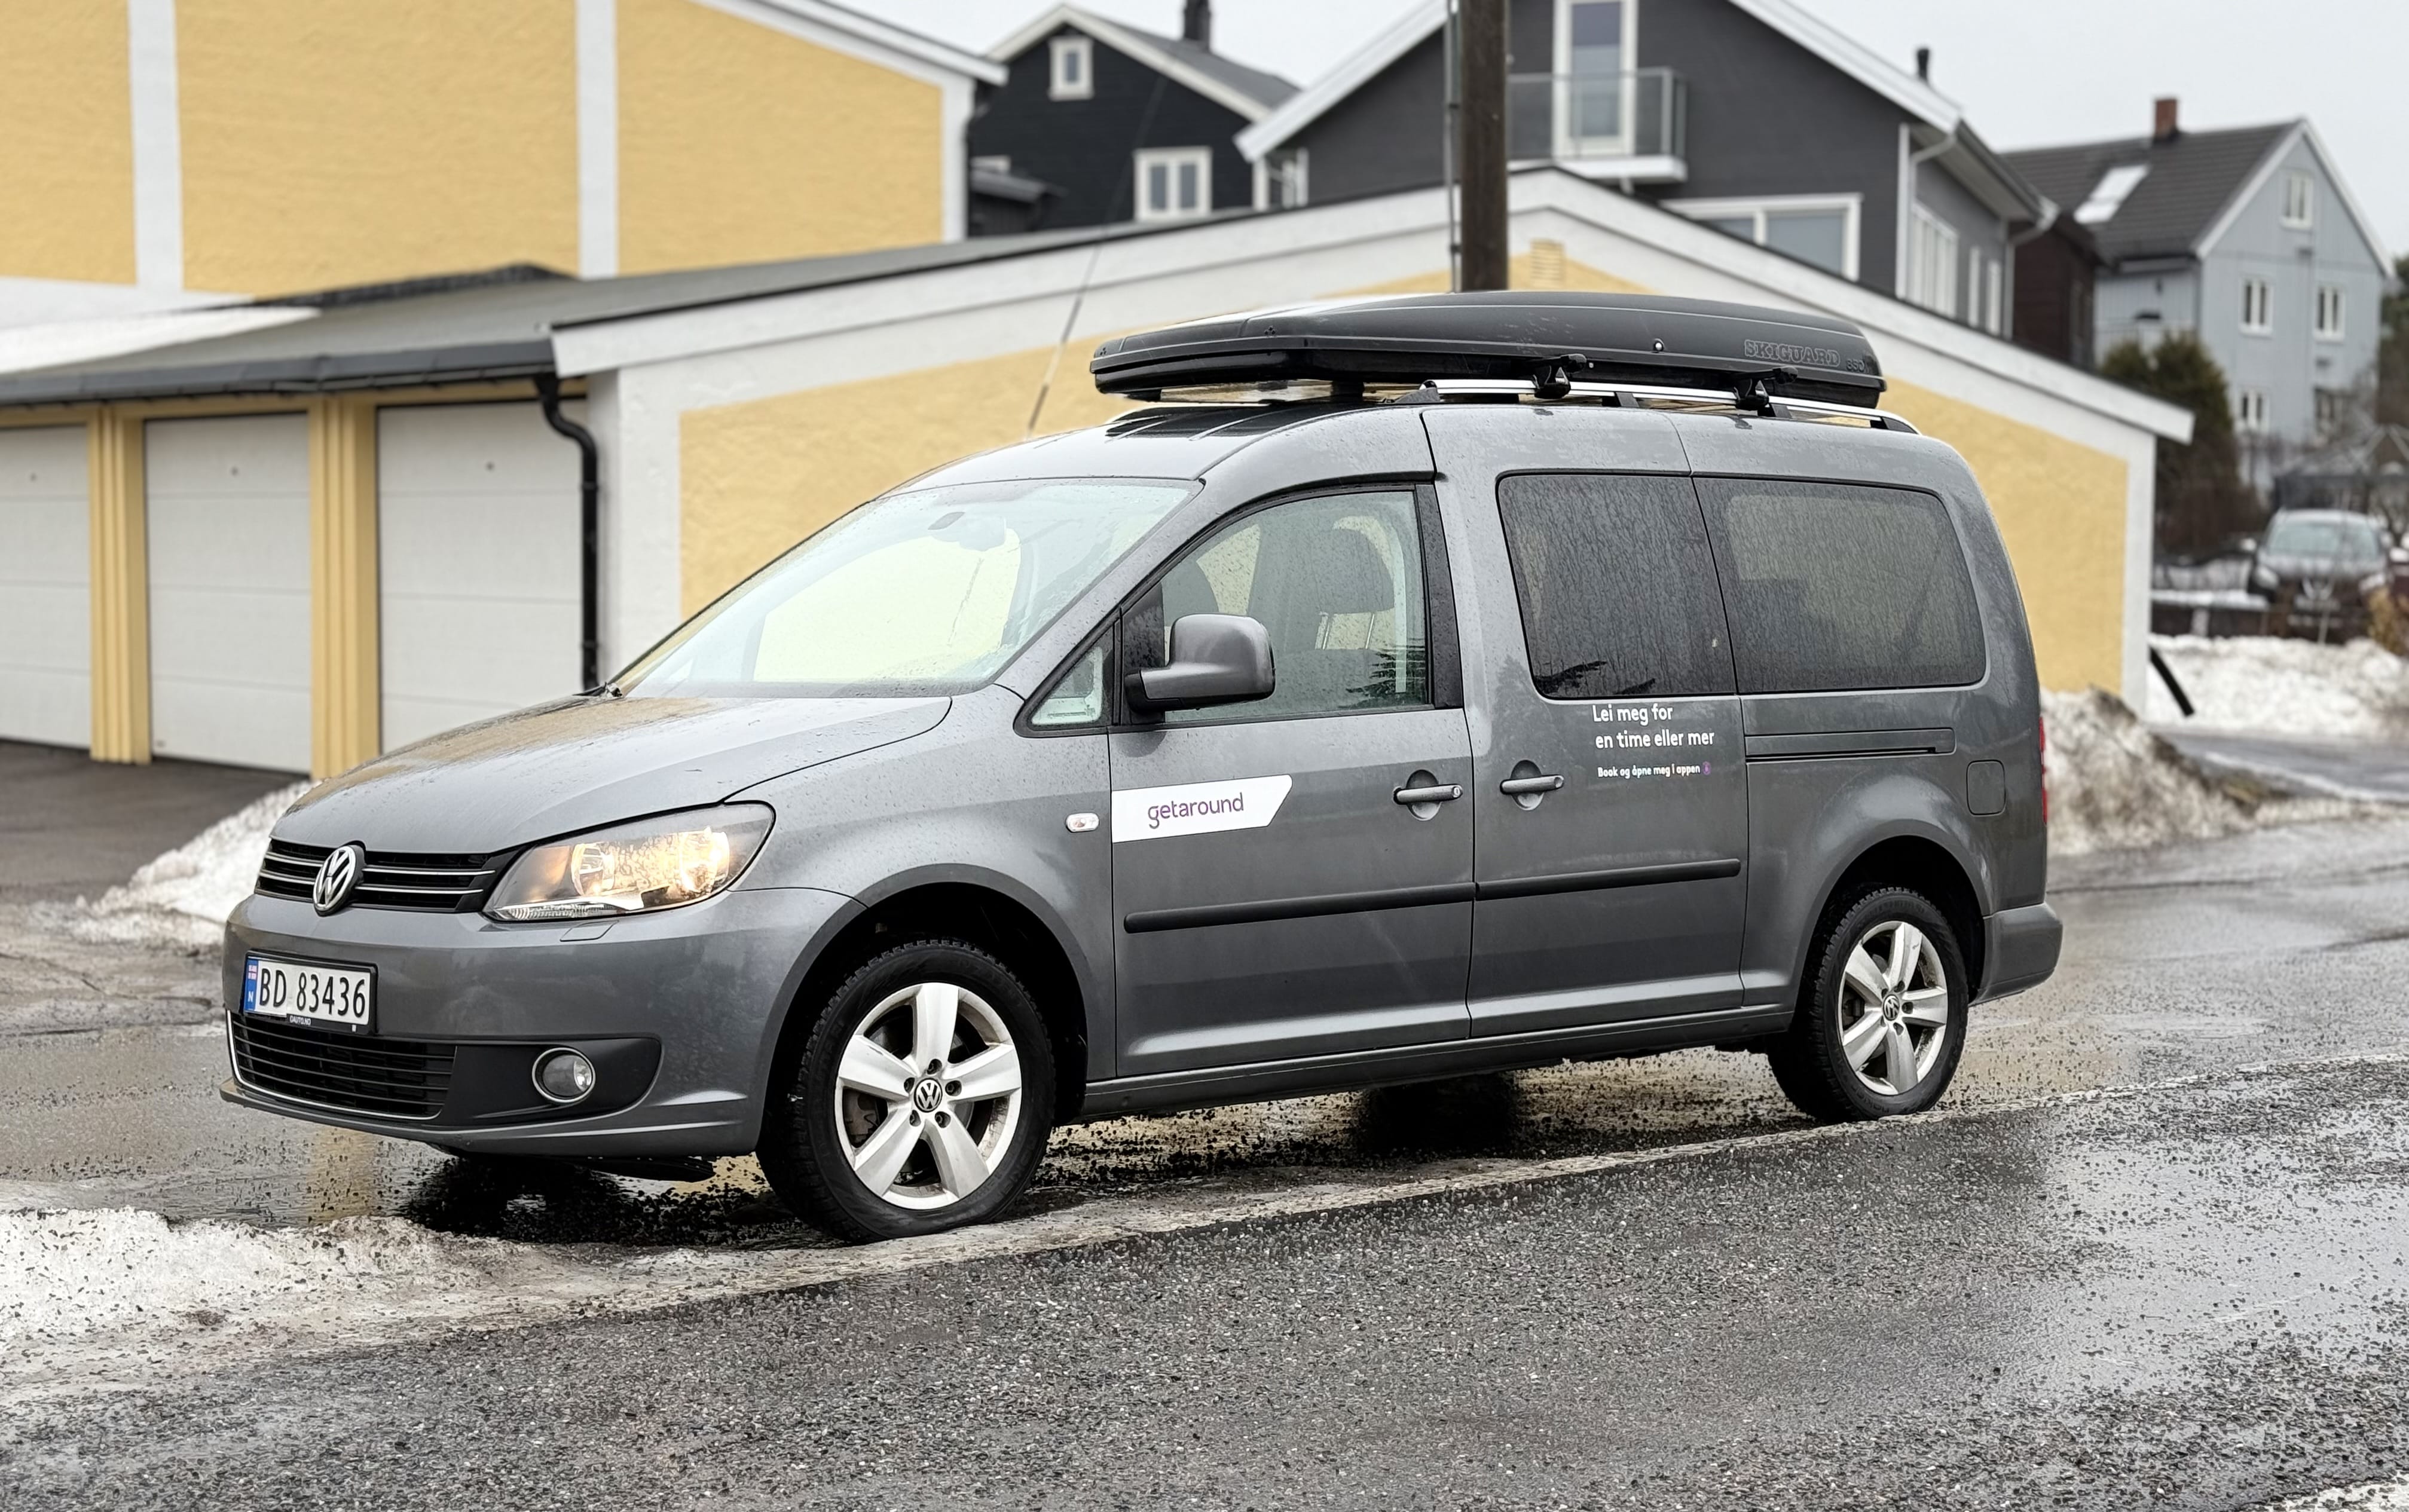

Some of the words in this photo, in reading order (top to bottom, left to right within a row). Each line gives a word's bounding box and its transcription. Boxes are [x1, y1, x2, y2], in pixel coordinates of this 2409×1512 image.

[1744, 339, 1841, 367] SKIGUARD
[1592, 704, 1613, 722] Lei
[1617, 708, 1649, 726] meg
[1652, 703, 1673, 720] for
[1595, 734, 1613, 749] en
[1616, 730, 1651, 748] time
[1654, 729, 1684, 746] eller
[1687, 731, 1715, 746] mer
[1597, 767, 1618, 778] Book
[1620, 769, 1630, 779] og
[1632, 764, 1652, 779] åpne
[1653, 767, 1671, 777] meg
[1676, 766, 1701, 777] appen
[1148, 792, 1245, 829] getaround
[247, 991, 253, 1003] N
[259, 968, 287, 1008] BD
[296, 972, 366, 1018] 83436
